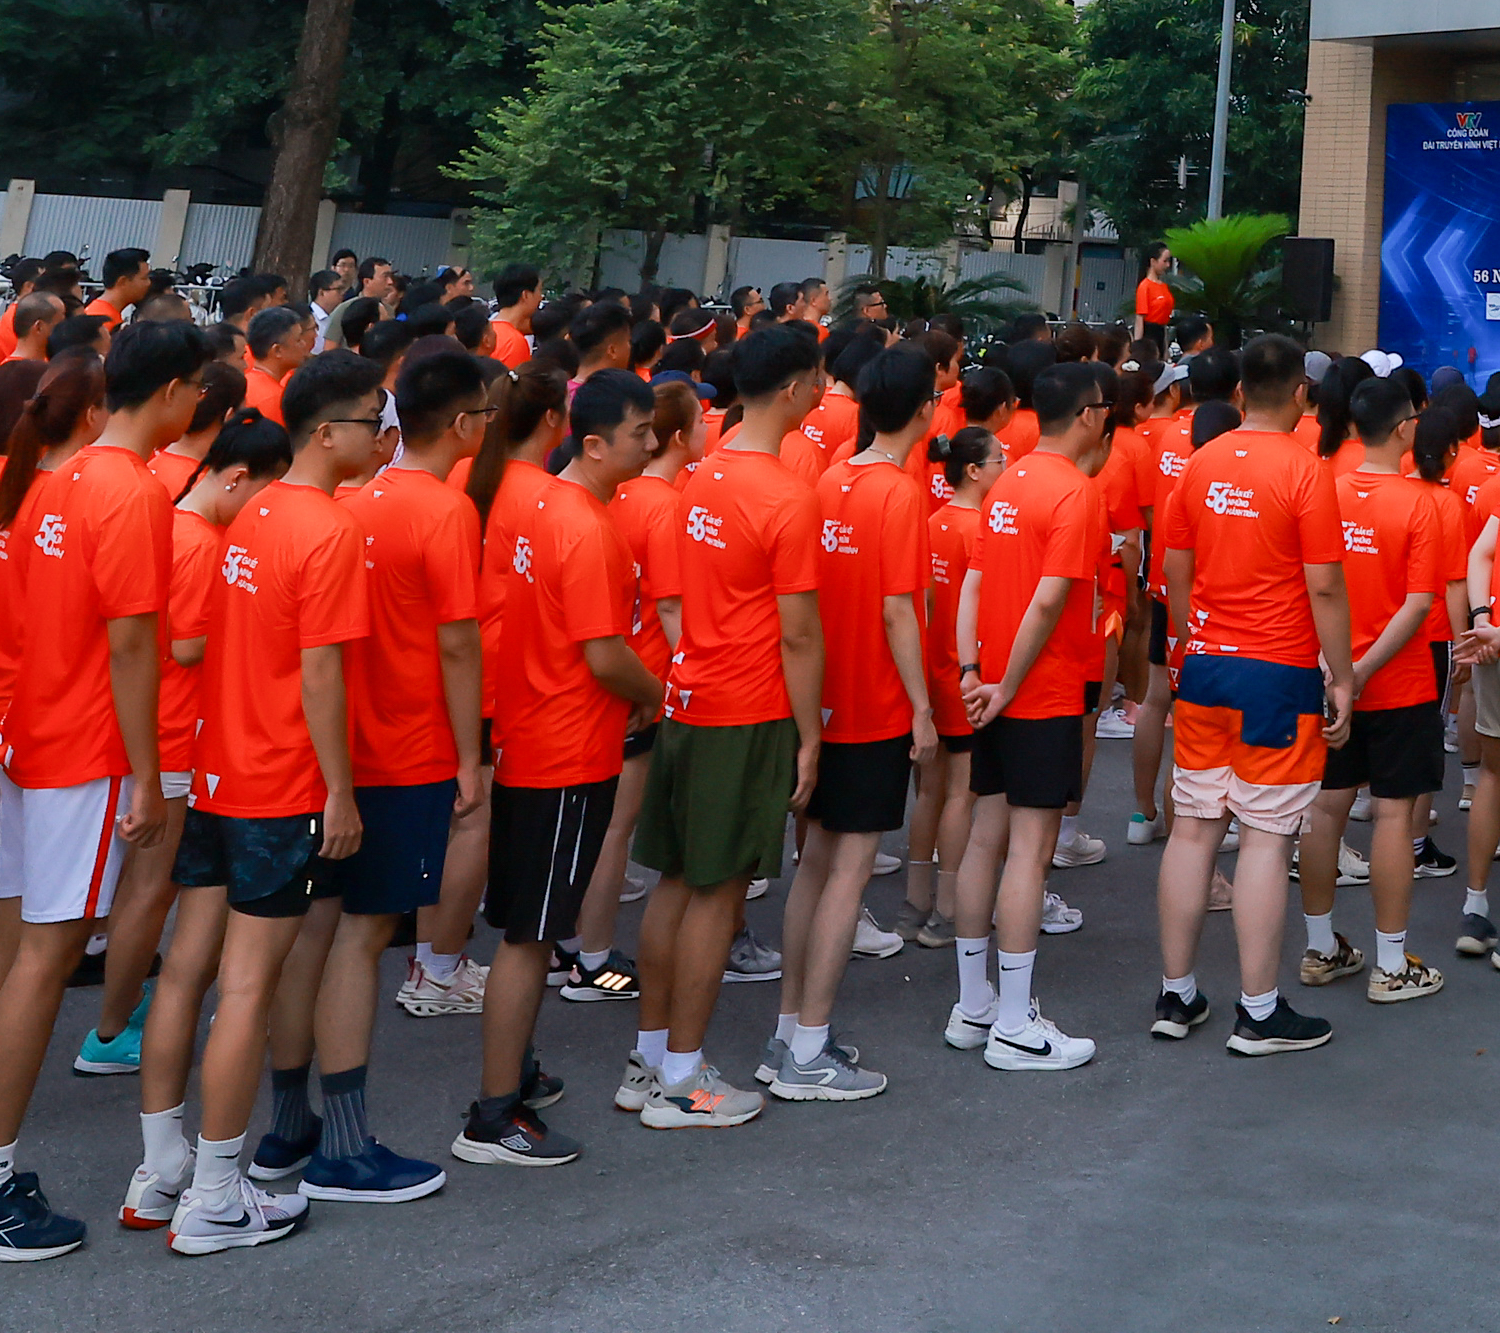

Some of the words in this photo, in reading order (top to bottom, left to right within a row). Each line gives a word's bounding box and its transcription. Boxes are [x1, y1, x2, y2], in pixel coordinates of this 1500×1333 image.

[1473, 270, 1489, 283] 56
[1204, 481, 1230, 515] 56
[687, 505, 706, 541] 56
[989, 501, 1007, 533] 56
[821, 519, 838, 552] 56
[222, 545, 243, 585] 56
